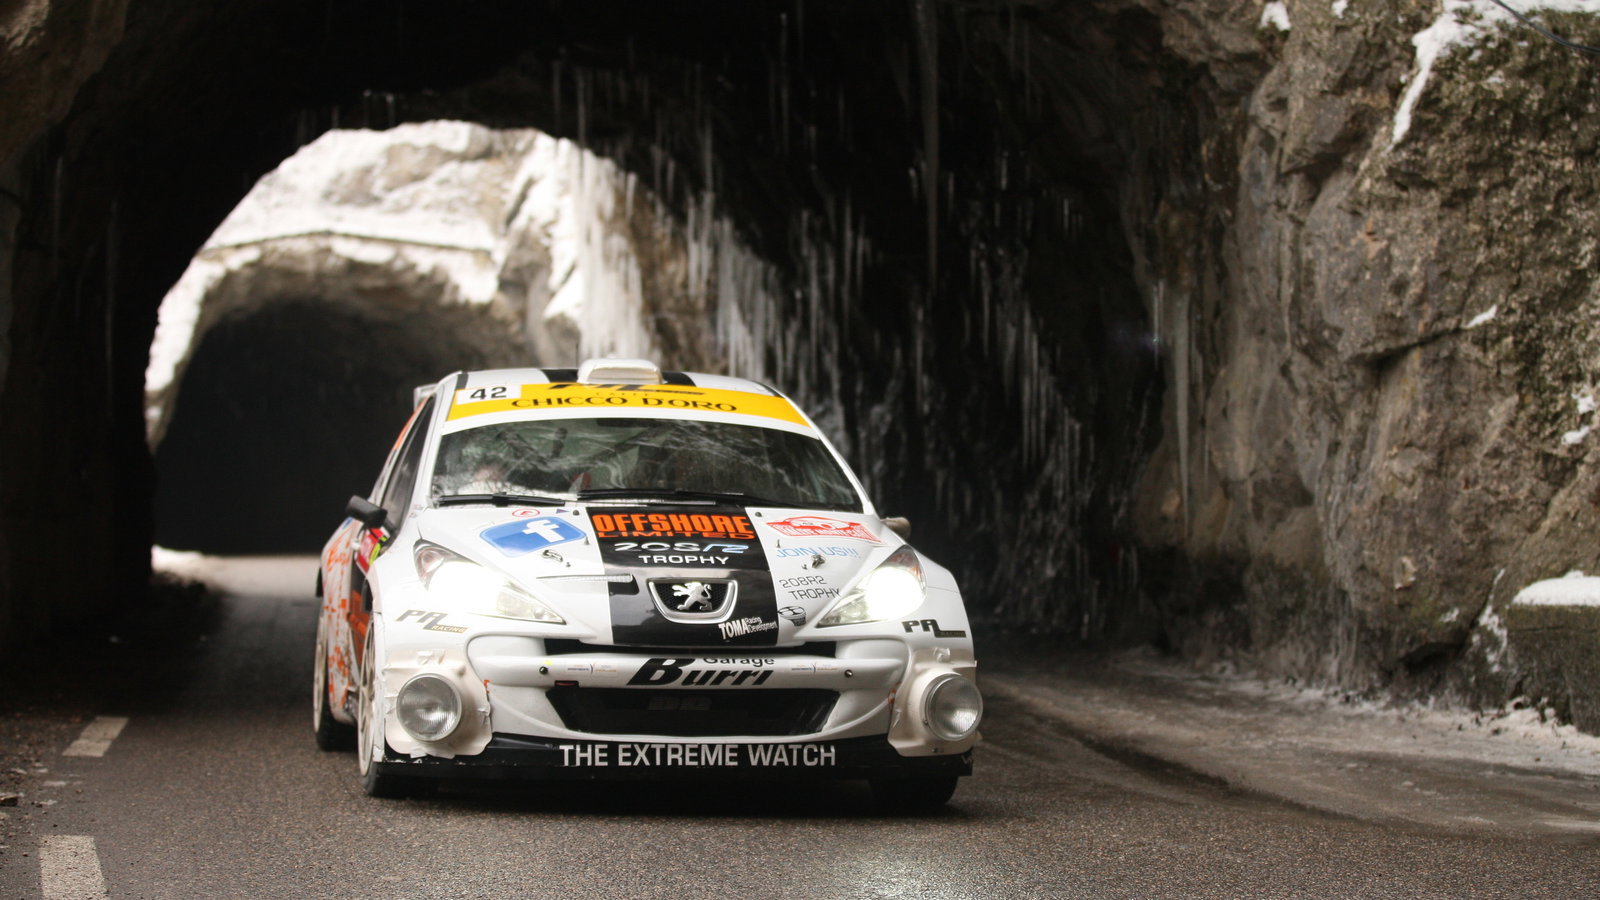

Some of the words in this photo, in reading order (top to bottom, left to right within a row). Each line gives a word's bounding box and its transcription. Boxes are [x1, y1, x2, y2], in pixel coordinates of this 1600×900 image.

[470, 386, 508, 400] 42
[511, 396, 628, 408] CHICCO
[641, 397, 737, 412] D'ORO
[592, 513, 754, 534] OFFSHORE
[598, 531, 755, 540] LIMITED
[776, 547, 817, 558] JOIN
[638, 555, 729, 565] TROPHY
[779, 575, 828, 589] 208R2
[788, 588, 842, 601] TROPHY
[431, 624, 466, 633] RACING
[718, 618, 751, 640] TOMA
[703, 657, 775, 667] Garage
[626, 657, 774, 685] Burri
[559, 744, 609, 767] THE
[617, 744, 739, 767] EXTREME
[747, 744, 836, 767] WATCH
